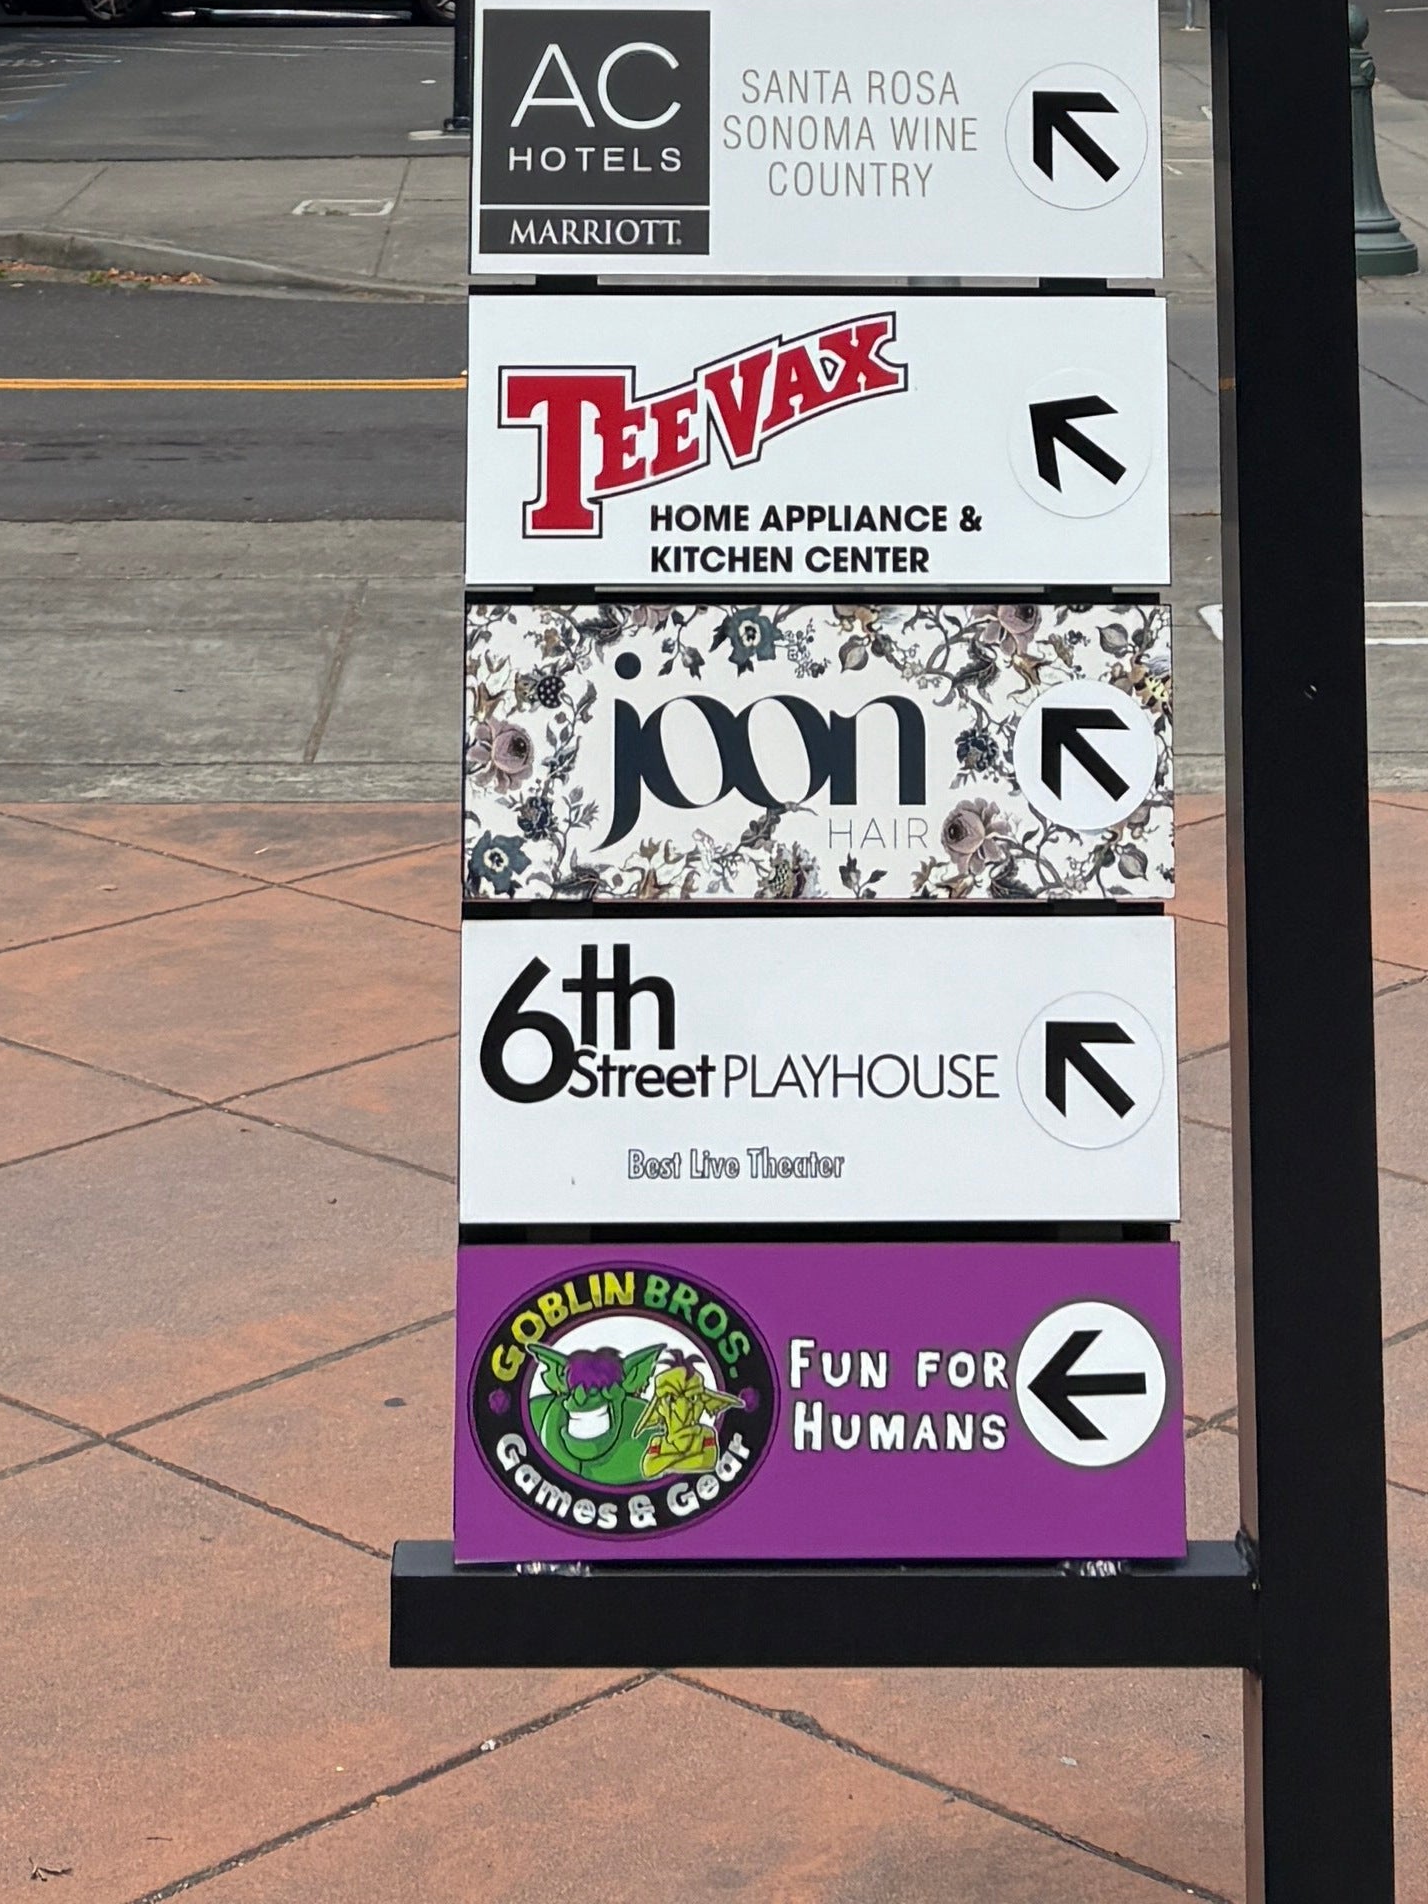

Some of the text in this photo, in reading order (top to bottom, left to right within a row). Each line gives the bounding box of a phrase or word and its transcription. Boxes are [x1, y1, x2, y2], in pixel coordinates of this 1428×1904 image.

[509, 41, 681, 130] AC
[741, 69, 960, 106] SANTA ROSA
[722, 115, 978, 152] SONOMA WINE
[508, 147, 682, 172] HOTELS
[768, 161, 933, 197] COUNTRY
[651, 504, 983, 533] HOME APPLIANCE &
[651, 545, 930, 573] KITCHEN CENTER
[590, 652, 926, 852] joon
[829, 818, 928, 848] HAIR
[480, 944, 675, 1103] 6th
[571, 1049, 1000, 1099] Street PLAYHOUSE
[628, 1147, 845, 1178] Best Live Theater
[491, 1272, 751, 1382] GOBLIN BROS.
[496, 1433, 750, 1529] Games & Gear
